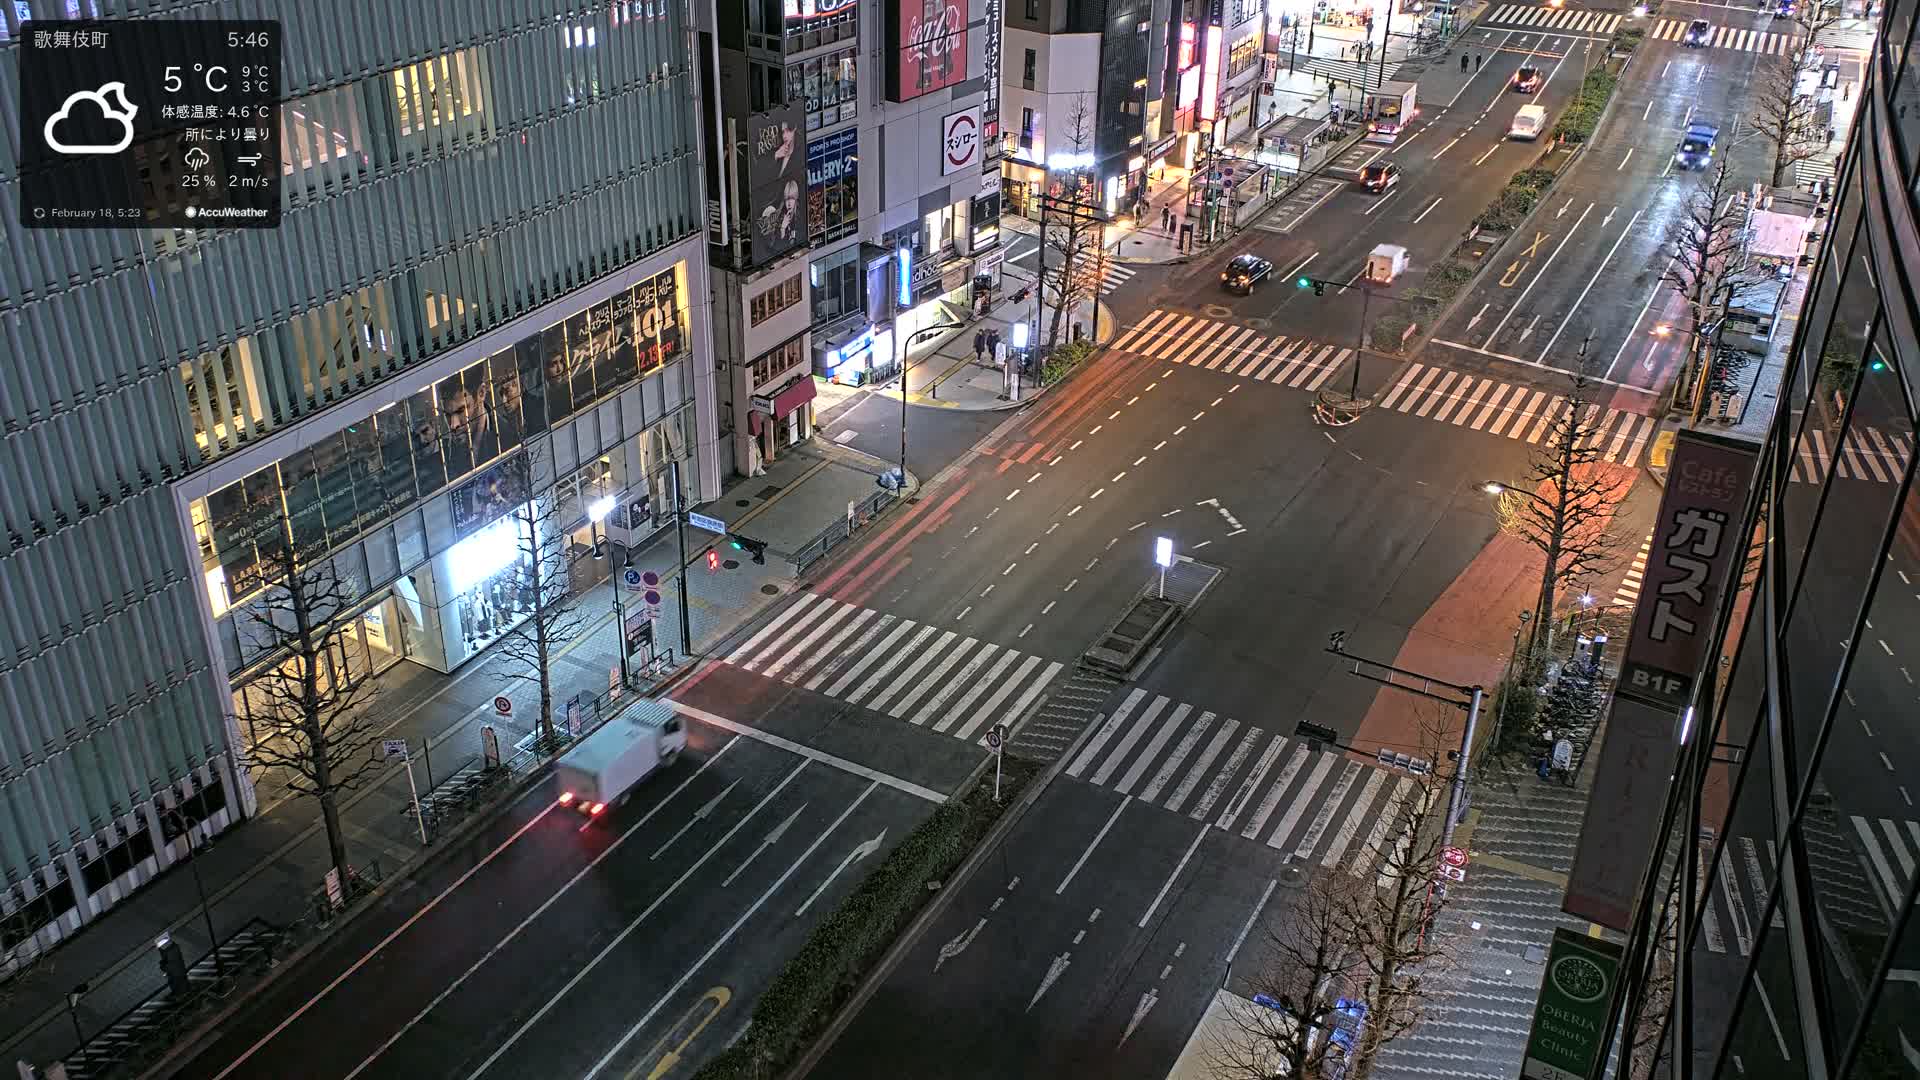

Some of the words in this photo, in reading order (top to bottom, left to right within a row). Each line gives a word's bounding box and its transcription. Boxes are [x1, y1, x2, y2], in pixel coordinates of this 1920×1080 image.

[809, 141, 829, 154] SPORTS
[946, 133, 978, 152] スシロー
[709, 199, 721, 233] MUJI
[828, 224, 857, 240] BASKETBALL
[614, 304, 633, 320] ラファロ
[616, 295, 633, 308] マーク
[630, 299, 676, 348] 101
[639, 343, 660, 369] 2.13
[1649, 508, 1727, 641] ガスト
[1631, 669, 1682, 695] B1F
[1541, 1003, 1596, 1033] OBERIA
[1541, 1019, 1588, 1046] Beauty
[1540, 1038, 1582, 1061] Clinic
